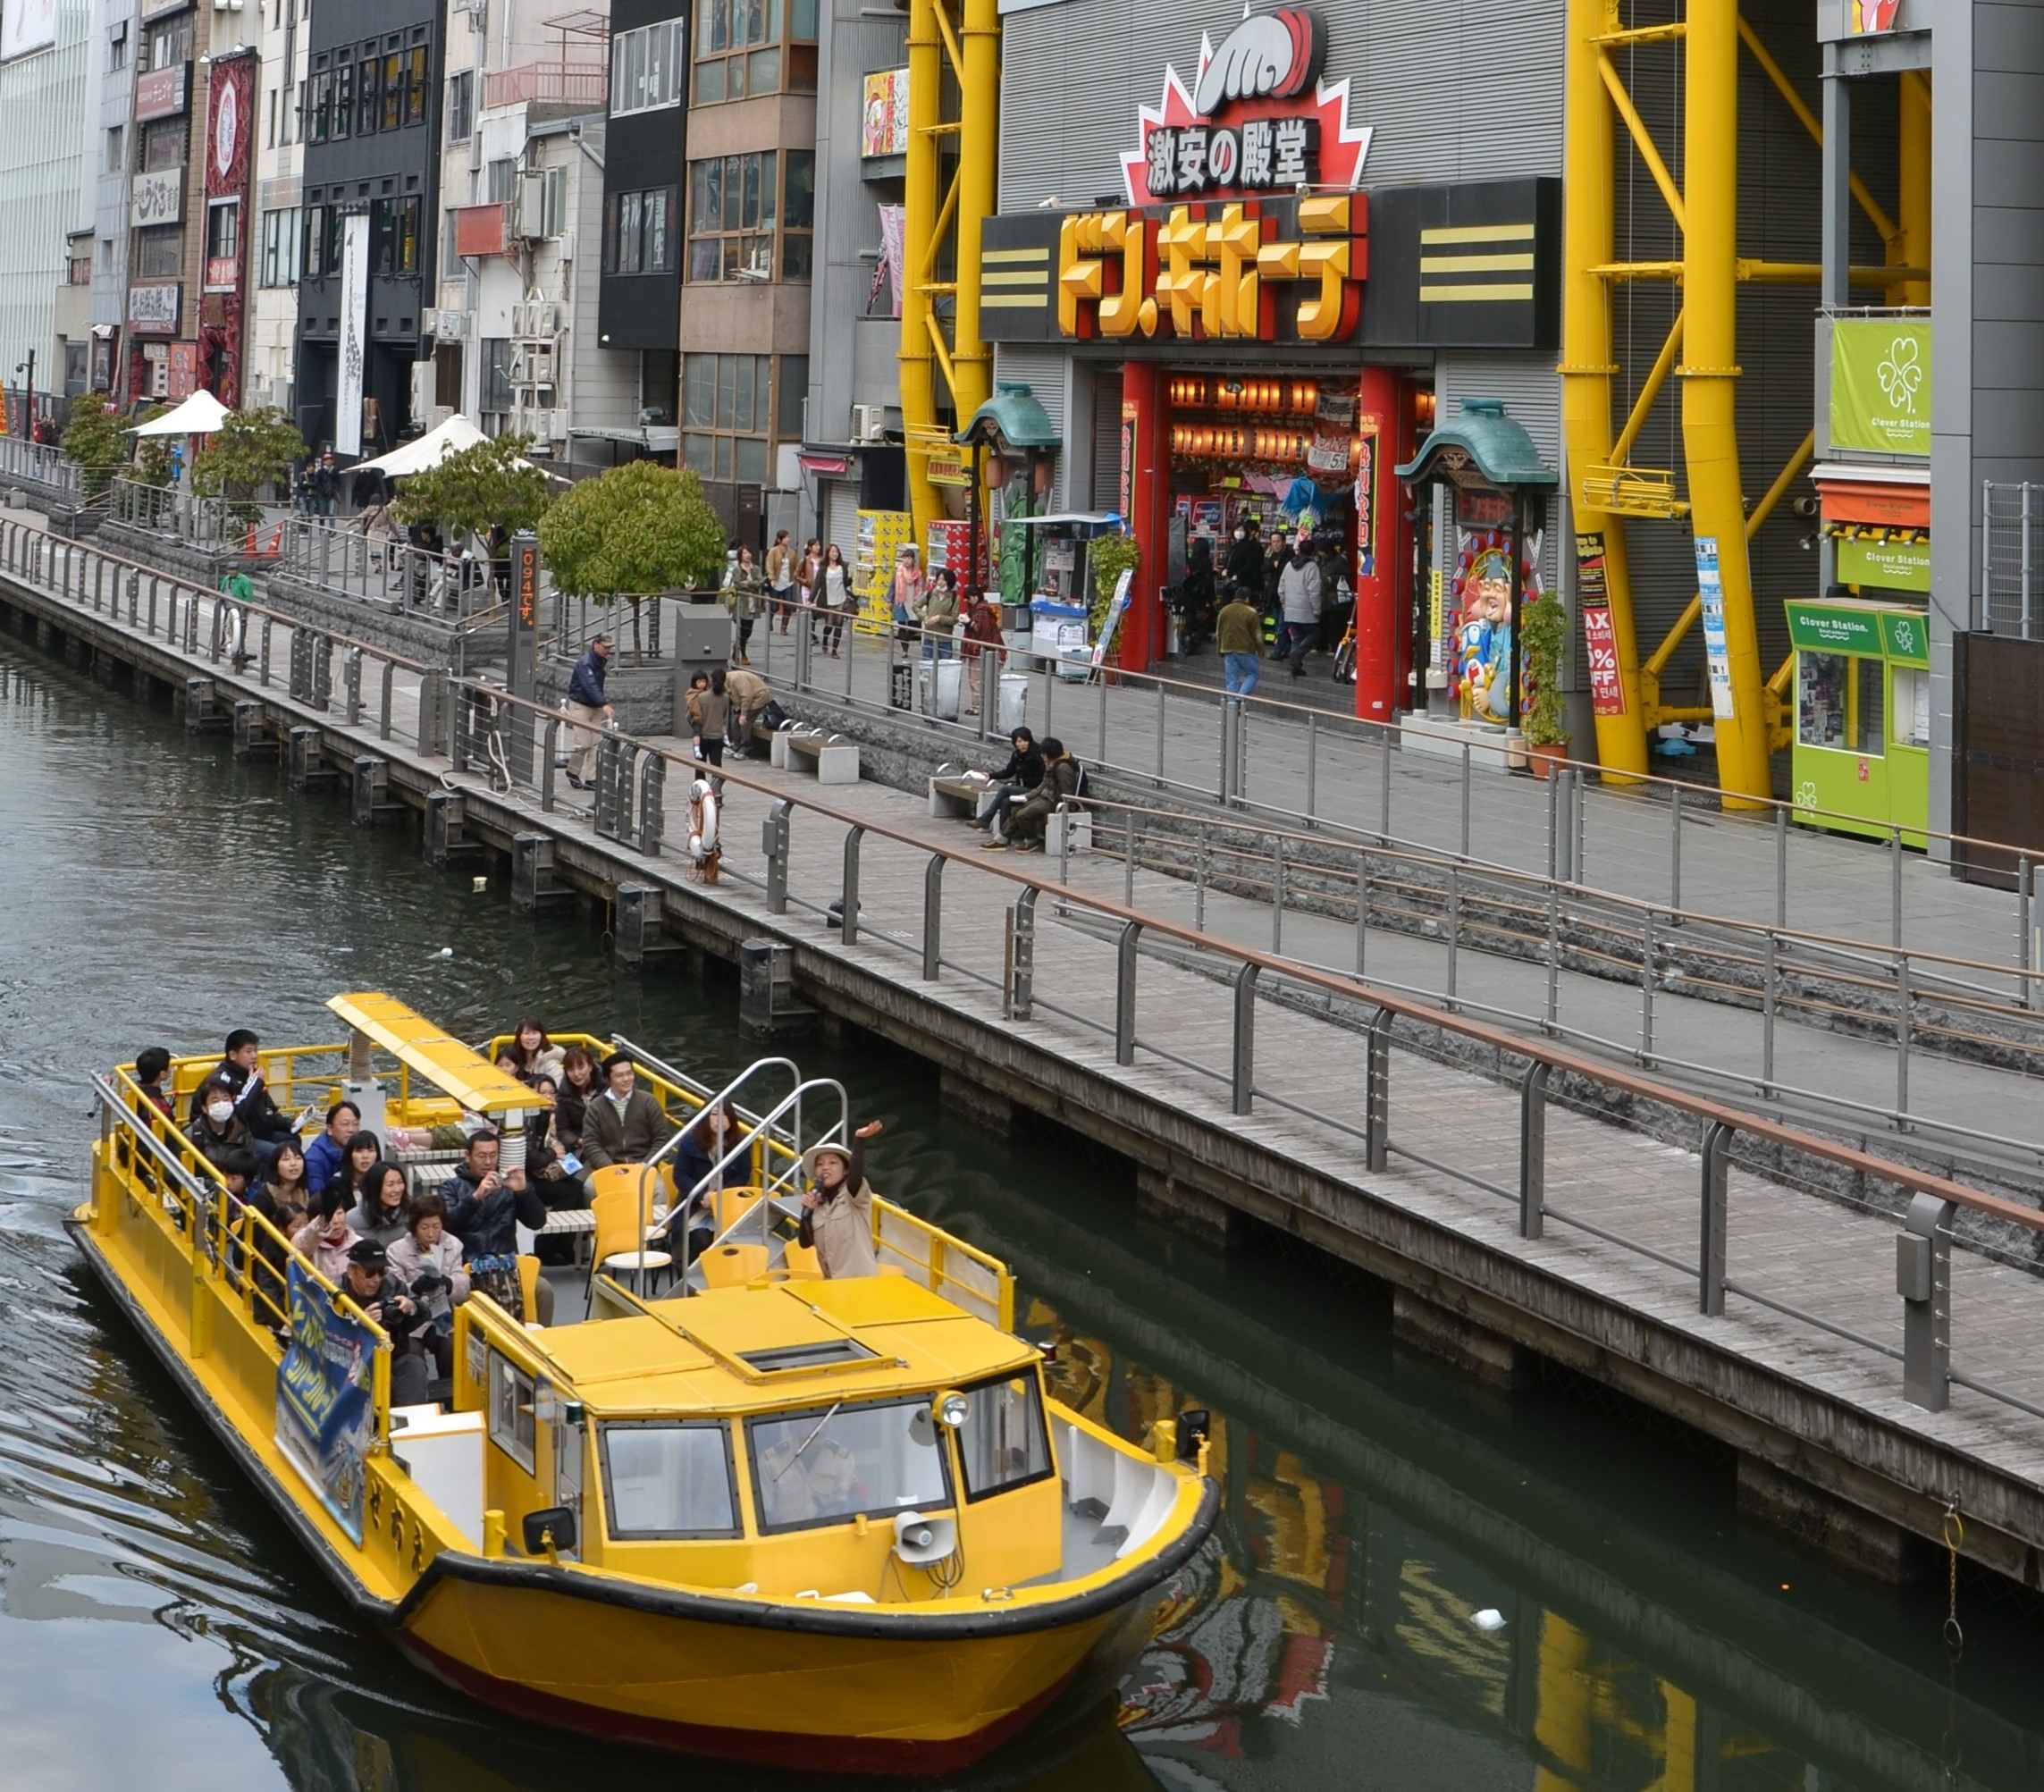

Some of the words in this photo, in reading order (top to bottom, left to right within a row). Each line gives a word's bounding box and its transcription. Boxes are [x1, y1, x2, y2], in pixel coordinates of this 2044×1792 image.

[1147, 118, 1308, 191] 激安の殿堂
[1872, 417, 1897, 427] Clover
[1900, 419, 1930, 428] Station
[1865, 551, 1896, 563] Clover
[1897, 554, 1930, 566] Station
[1585, 612, 1611, 629] AX
[1799, 616, 1830, 628] Clover
[1589, 669, 1616, 686] FF
